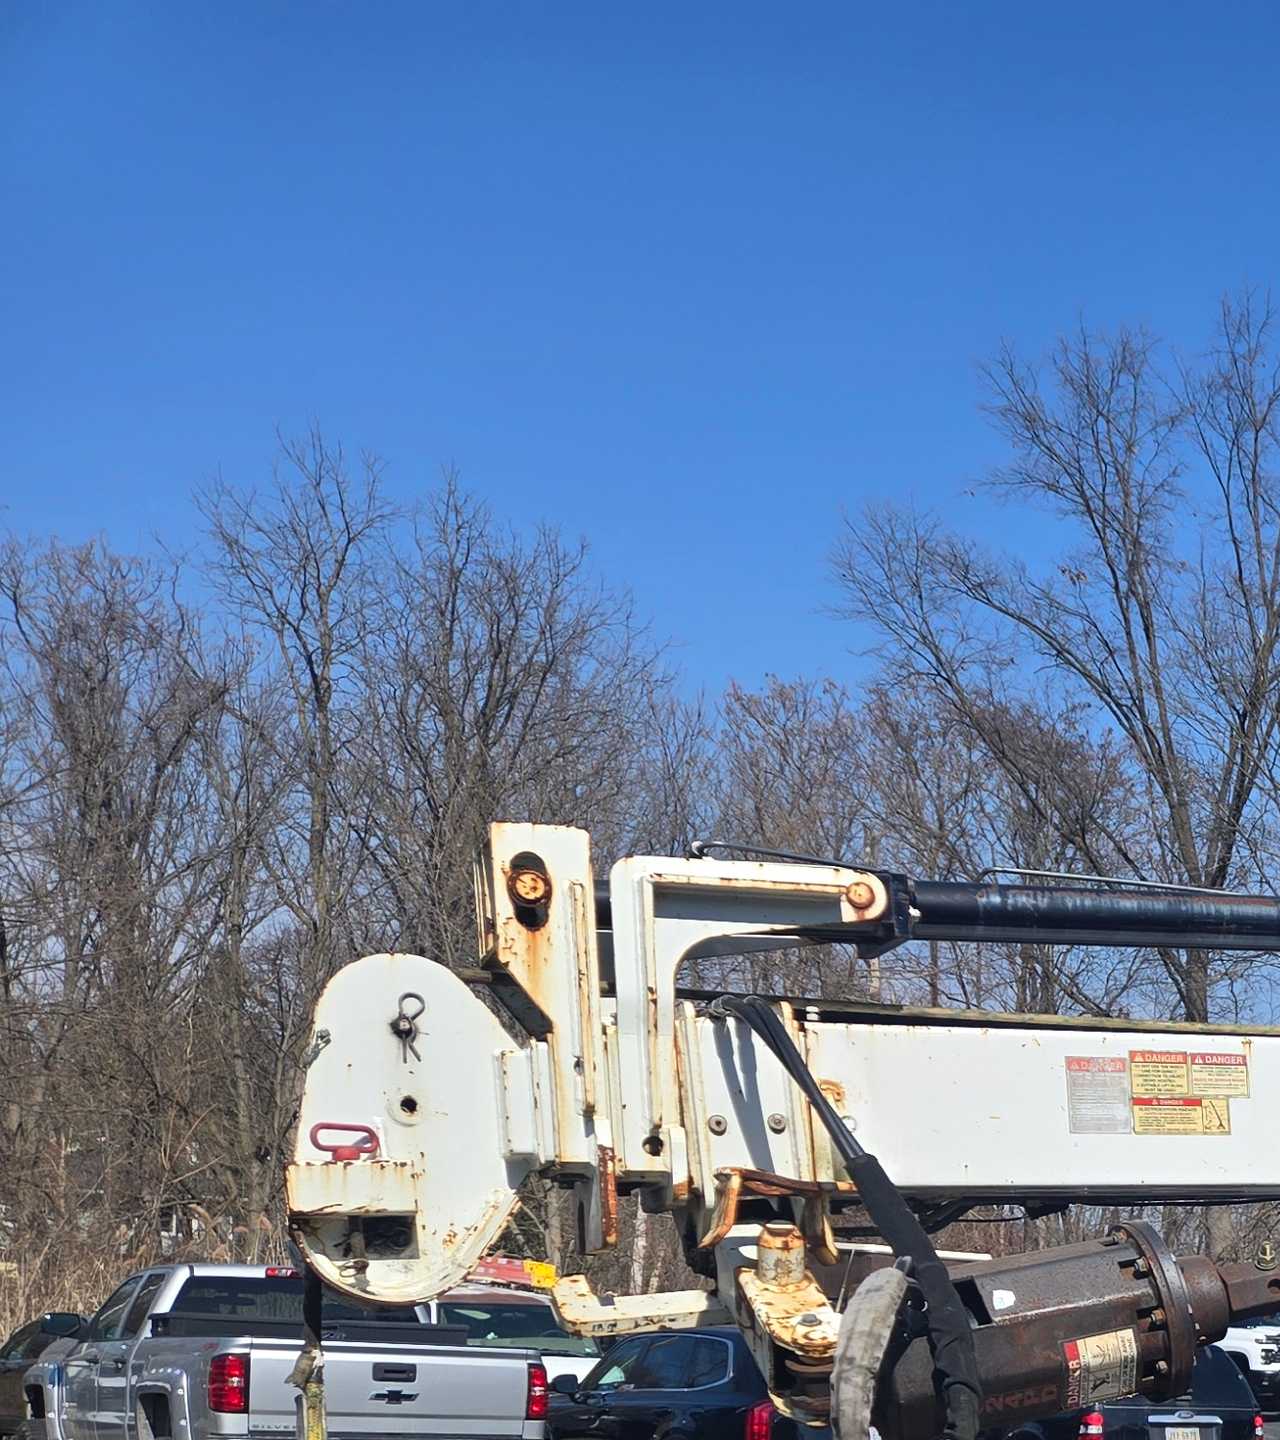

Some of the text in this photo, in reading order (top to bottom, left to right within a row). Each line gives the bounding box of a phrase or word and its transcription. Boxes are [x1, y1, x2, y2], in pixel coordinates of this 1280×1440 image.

[1144, 1053, 1185, 1063] DANGER
[1205, 1055, 1244, 1065] DANGER
[1080, 1060, 1124, 1072] DANGER
